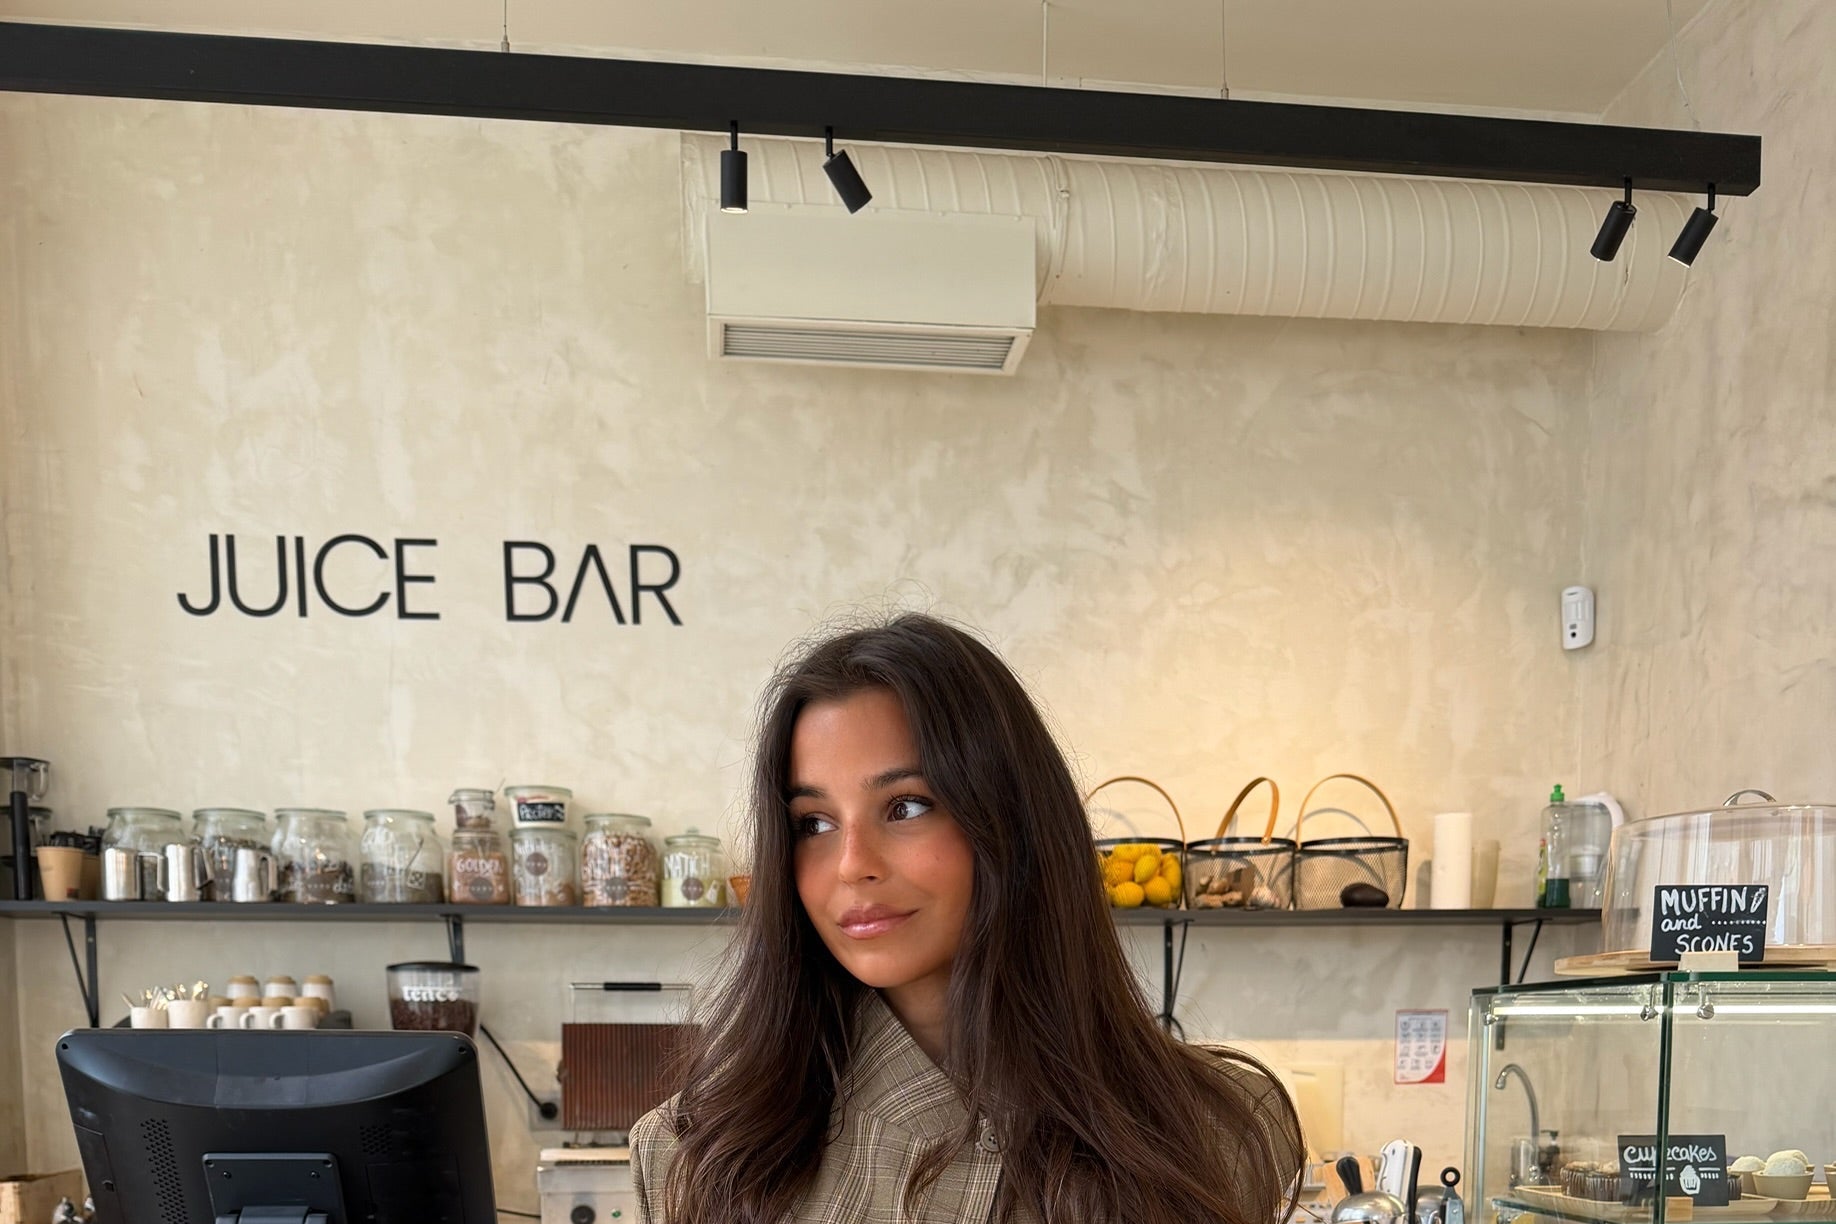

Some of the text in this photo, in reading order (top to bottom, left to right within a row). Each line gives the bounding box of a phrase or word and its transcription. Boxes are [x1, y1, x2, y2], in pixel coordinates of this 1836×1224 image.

[177, 533, 684, 626] JUICE BAR
[1660, 913, 1702, 932] and
[1674, 932, 1754, 955] SCONES
